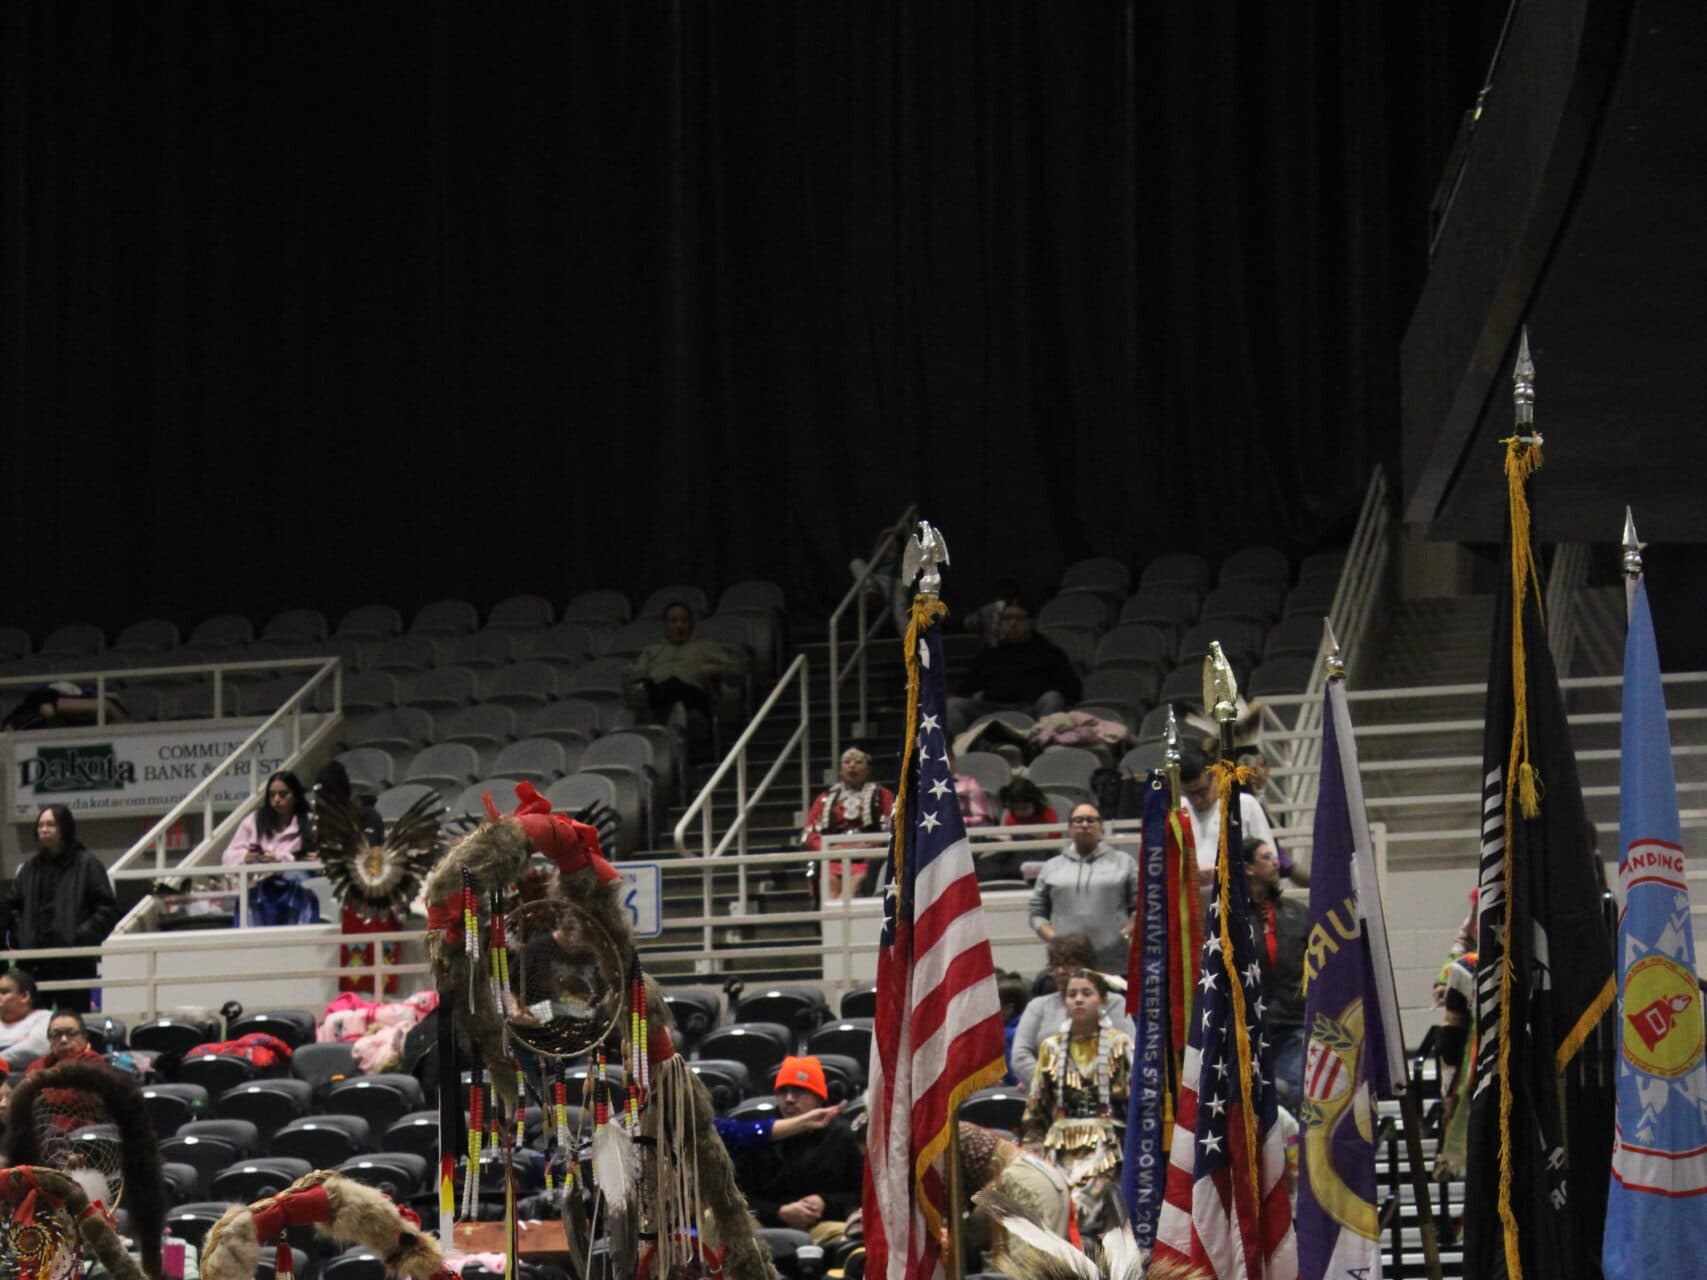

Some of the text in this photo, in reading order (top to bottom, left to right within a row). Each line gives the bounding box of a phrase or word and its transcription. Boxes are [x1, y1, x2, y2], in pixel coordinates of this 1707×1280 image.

[158, 740, 268, 760] COMMUNY
[18, 750, 137, 788] Dakota
[144, 763, 197, 781] BANK
[1136, 846, 1163, 1248] ND NATIVE VETERANS STAND DOWN 202
